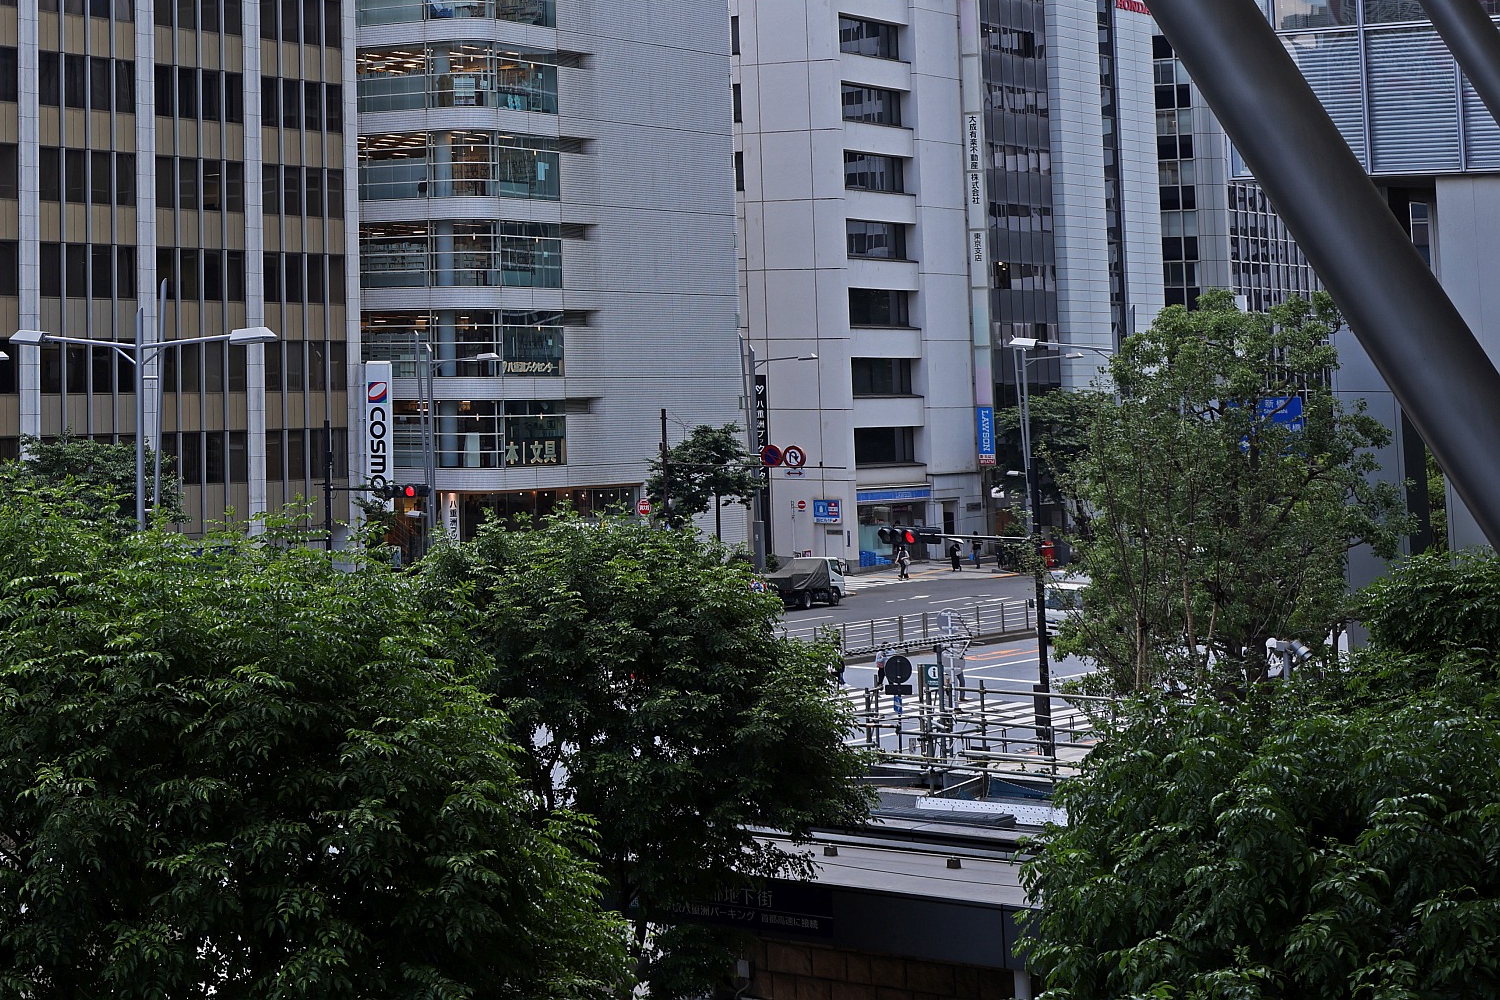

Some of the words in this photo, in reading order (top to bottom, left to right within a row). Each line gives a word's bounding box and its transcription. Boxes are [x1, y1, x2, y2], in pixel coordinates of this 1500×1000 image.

[968, 115, 979, 170] 大成有楽不動産
[970, 173, 980, 205] 株式会社
[973, 232, 982, 262] 東京支店
[981, 409, 991, 452] LAWSON
